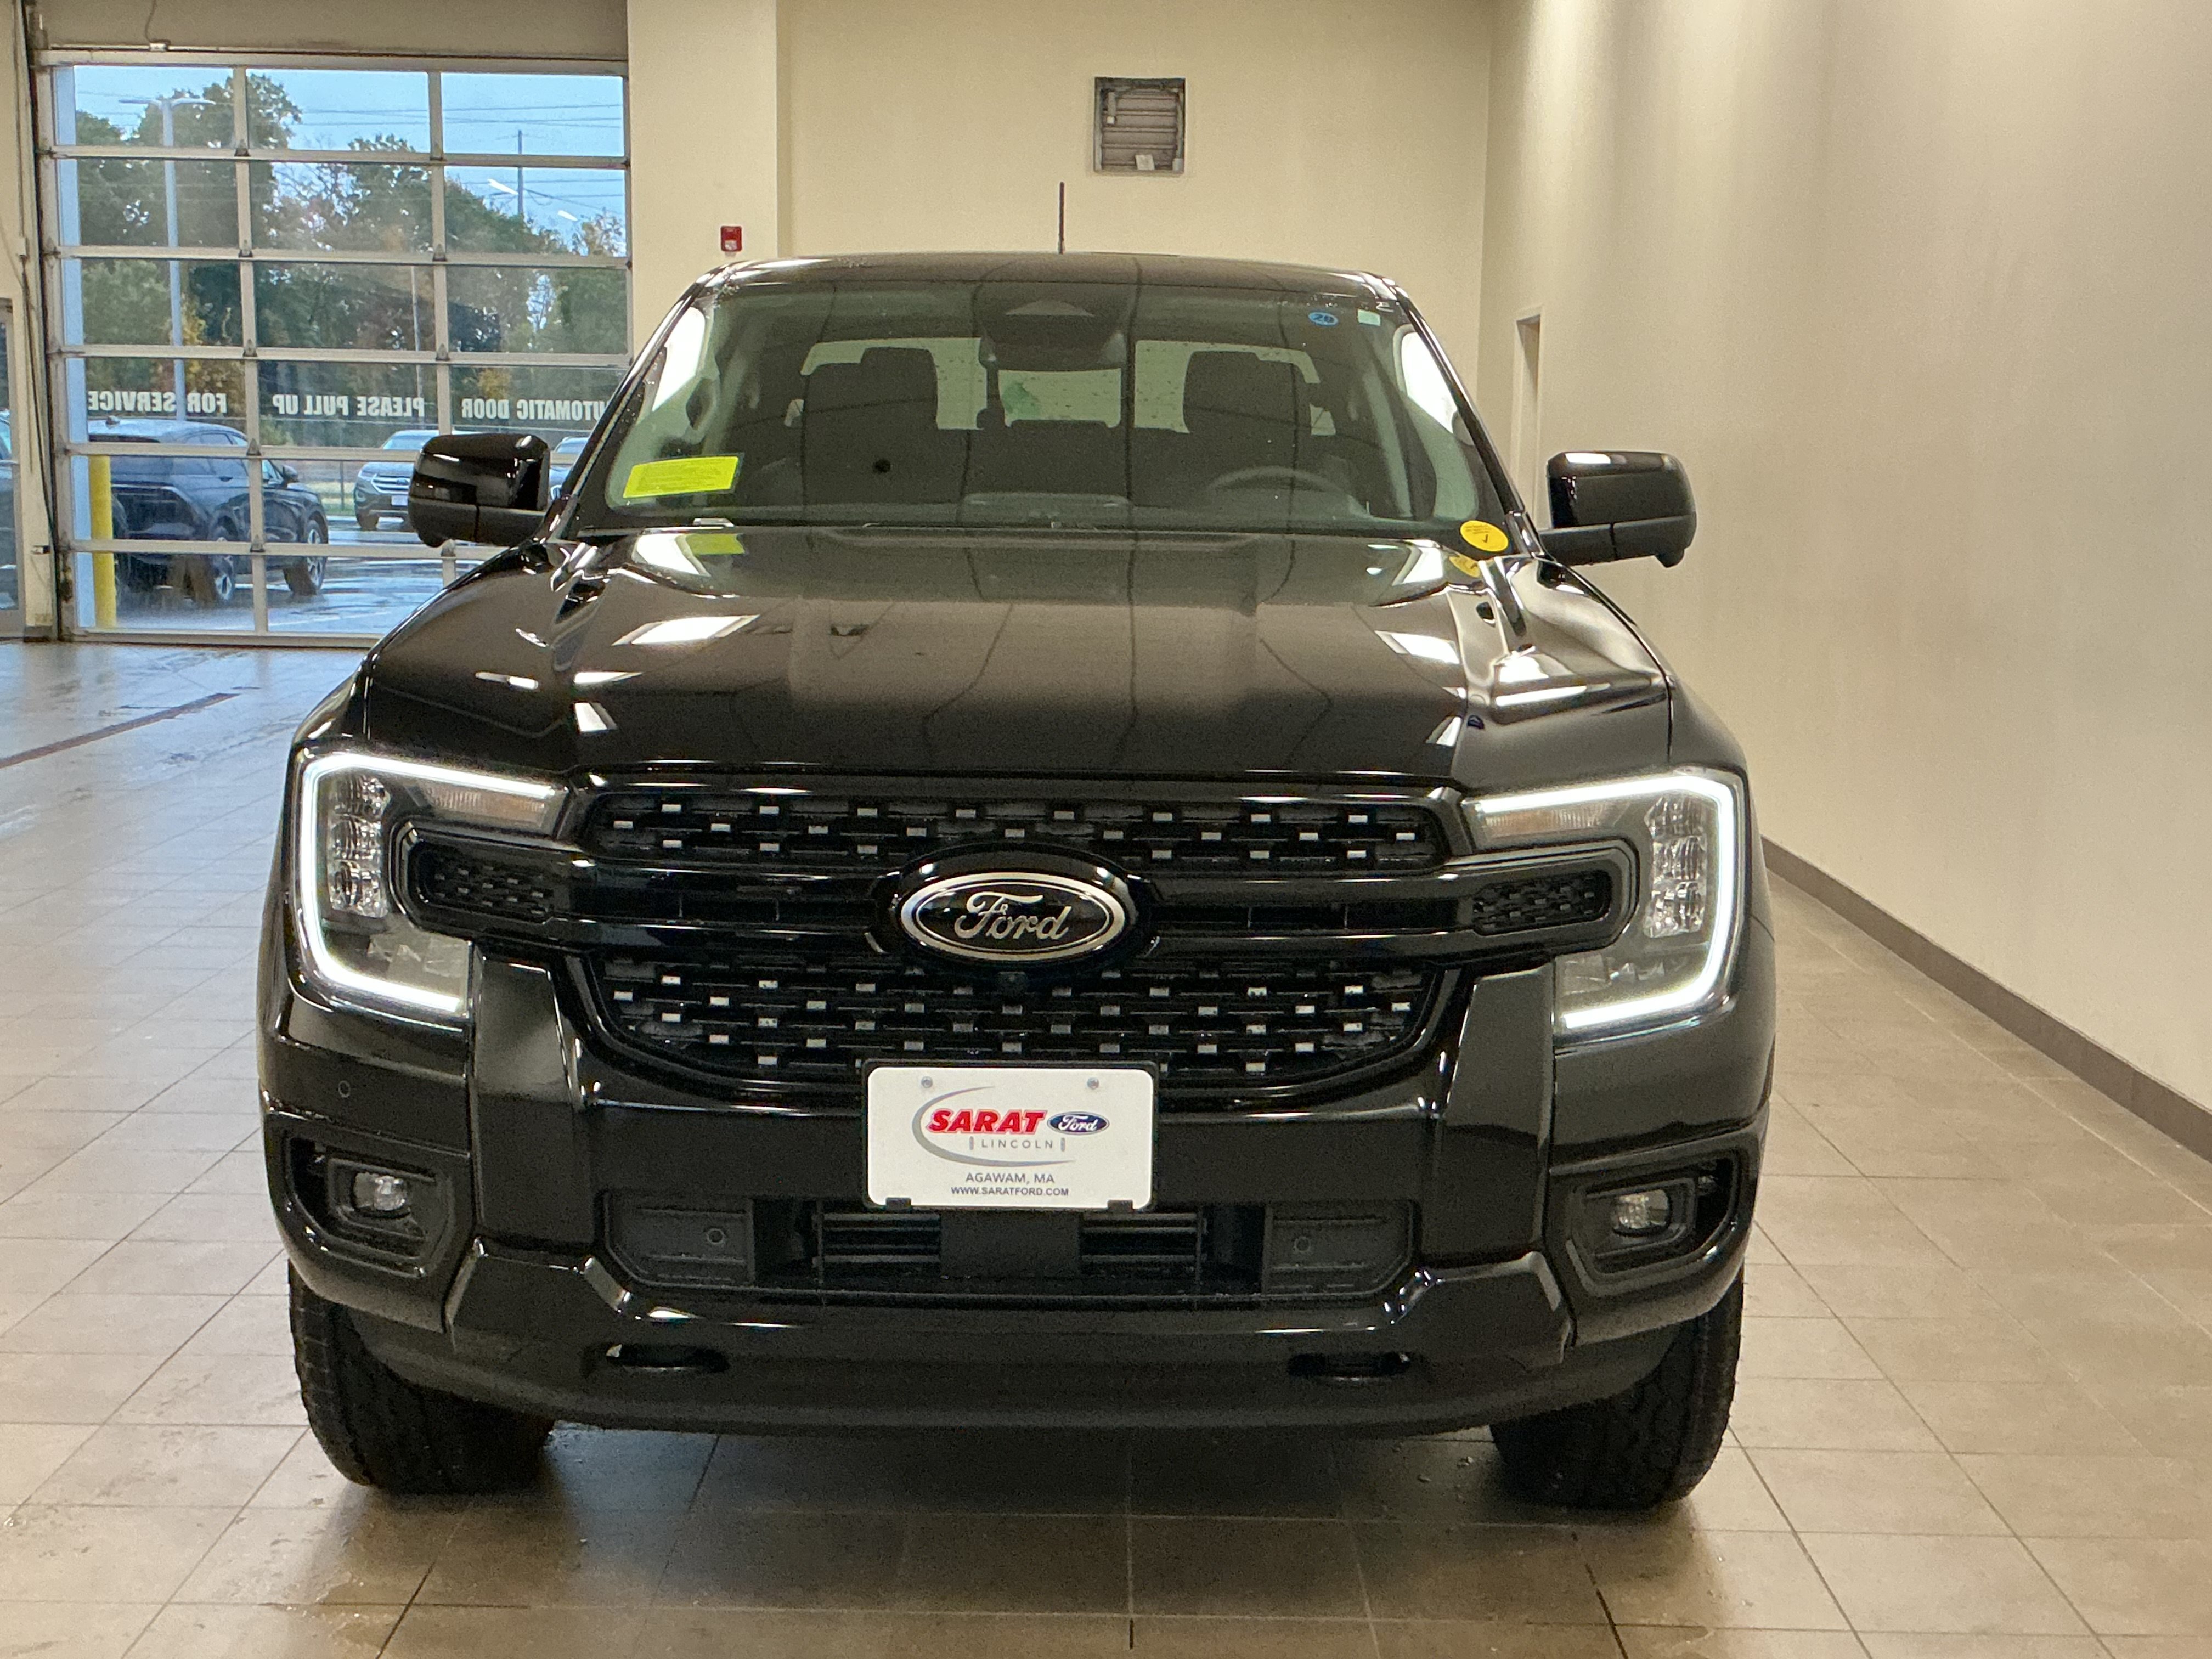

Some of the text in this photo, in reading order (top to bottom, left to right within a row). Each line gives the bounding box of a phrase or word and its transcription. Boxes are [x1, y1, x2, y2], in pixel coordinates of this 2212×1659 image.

[954, 891, 1073, 940] Ford
[927, 1109, 1099, 1133] SARAT Ford
[981, 1139, 1054, 1149] LINCOLN
[965, 1172, 1055, 1185] AGAWAM, MA
[951, 1186, 1069, 1197] WWW.SARATFORD.COM
